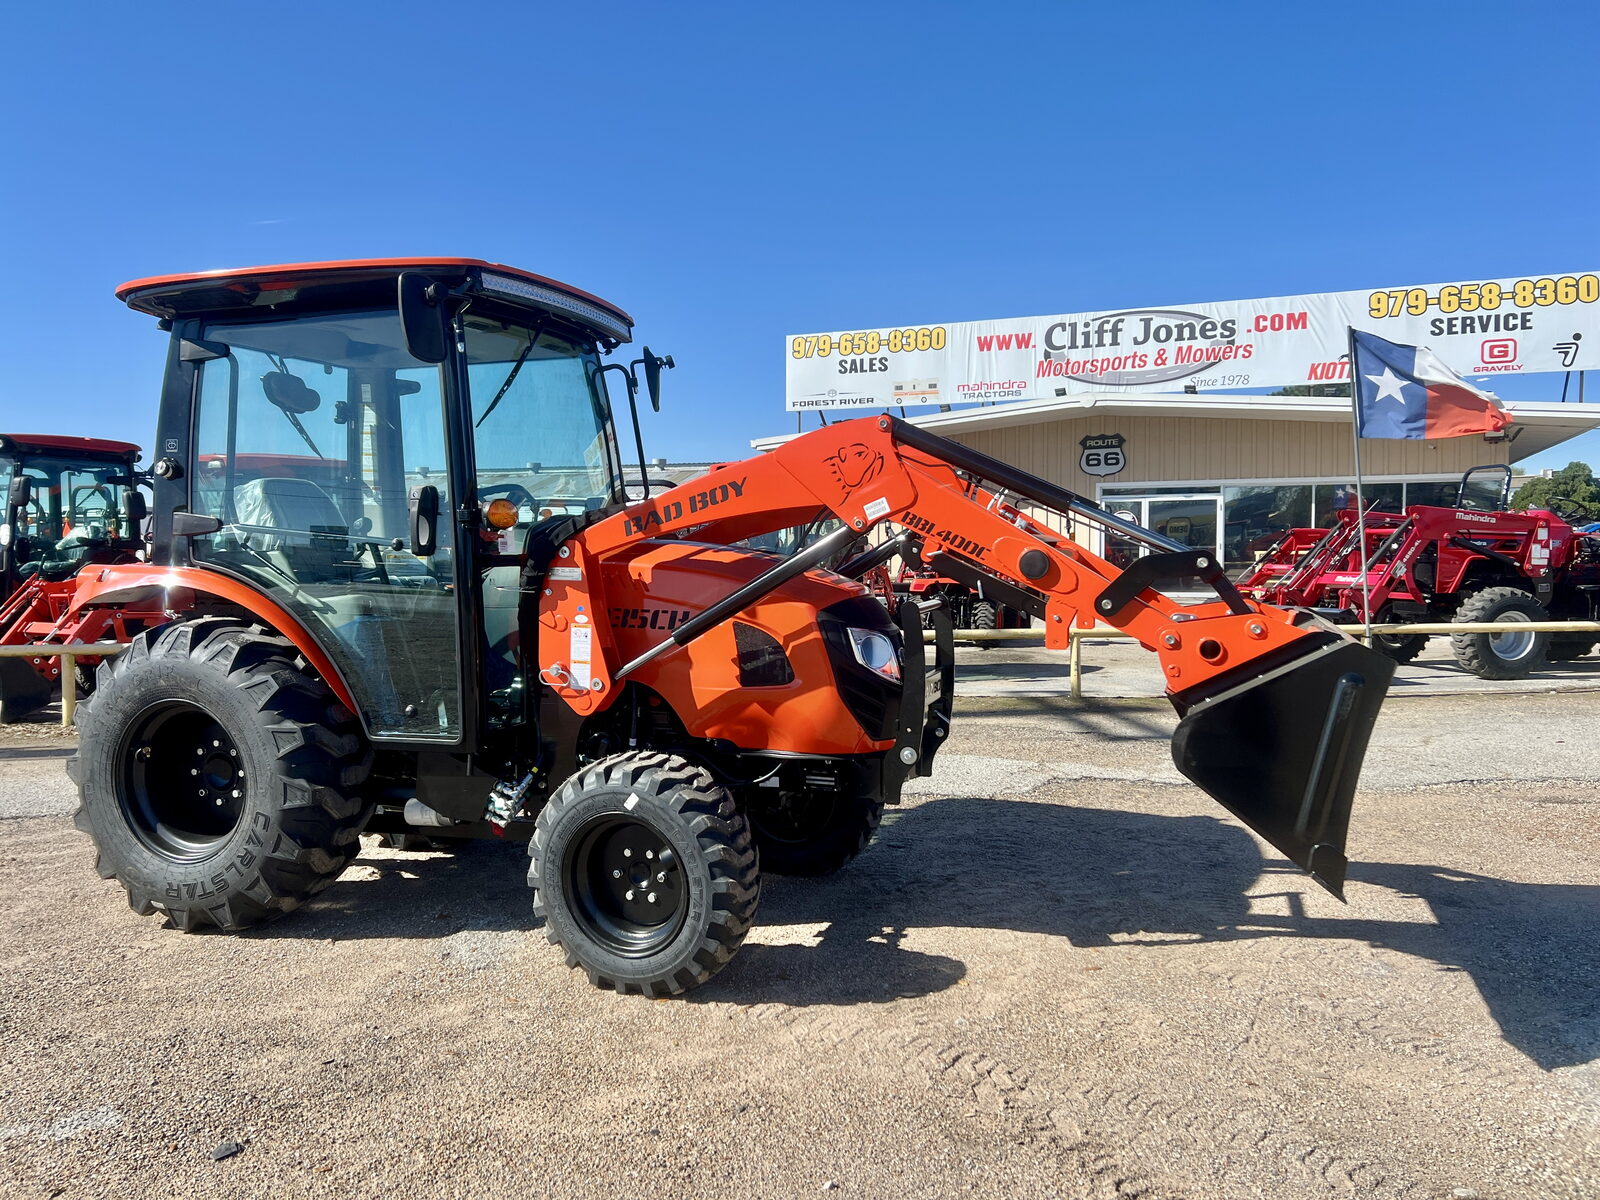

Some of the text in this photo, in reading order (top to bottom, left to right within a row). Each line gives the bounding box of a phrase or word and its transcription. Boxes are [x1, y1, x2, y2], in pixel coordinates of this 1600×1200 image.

[1369, 274, 1600, 319] 979-658-8360
[1246, 312, 1307, 333] .COM
[1430, 311, 1533, 336] SERVICE
[791, 326, 946, 359] 979-658-8360
[1044, 317, 1237, 351] Cliff Jones
[838, 357, 889, 375] SALES
[1036, 344, 1254, 378] Motorsports & Mowers
[1473, 364, 1523, 372] GRAVELY
[957, 379, 1026, 392] mahindra
[1190, 374, 1250, 387] Since 1978
[792, 397, 875, 408] FOREST RIVER
[963, 389, 1021, 399] TRACTORS
[1086, 438, 1119, 447] ROUTE
[1085, 451, 1120, 467] 66
[624, 476, 747, 537] BAD BOY
[901, 511, 992, 560] BBL400C
[608, 608, 690, 630] 35CH
[165, 811, 271, 901] CARLSTAR
